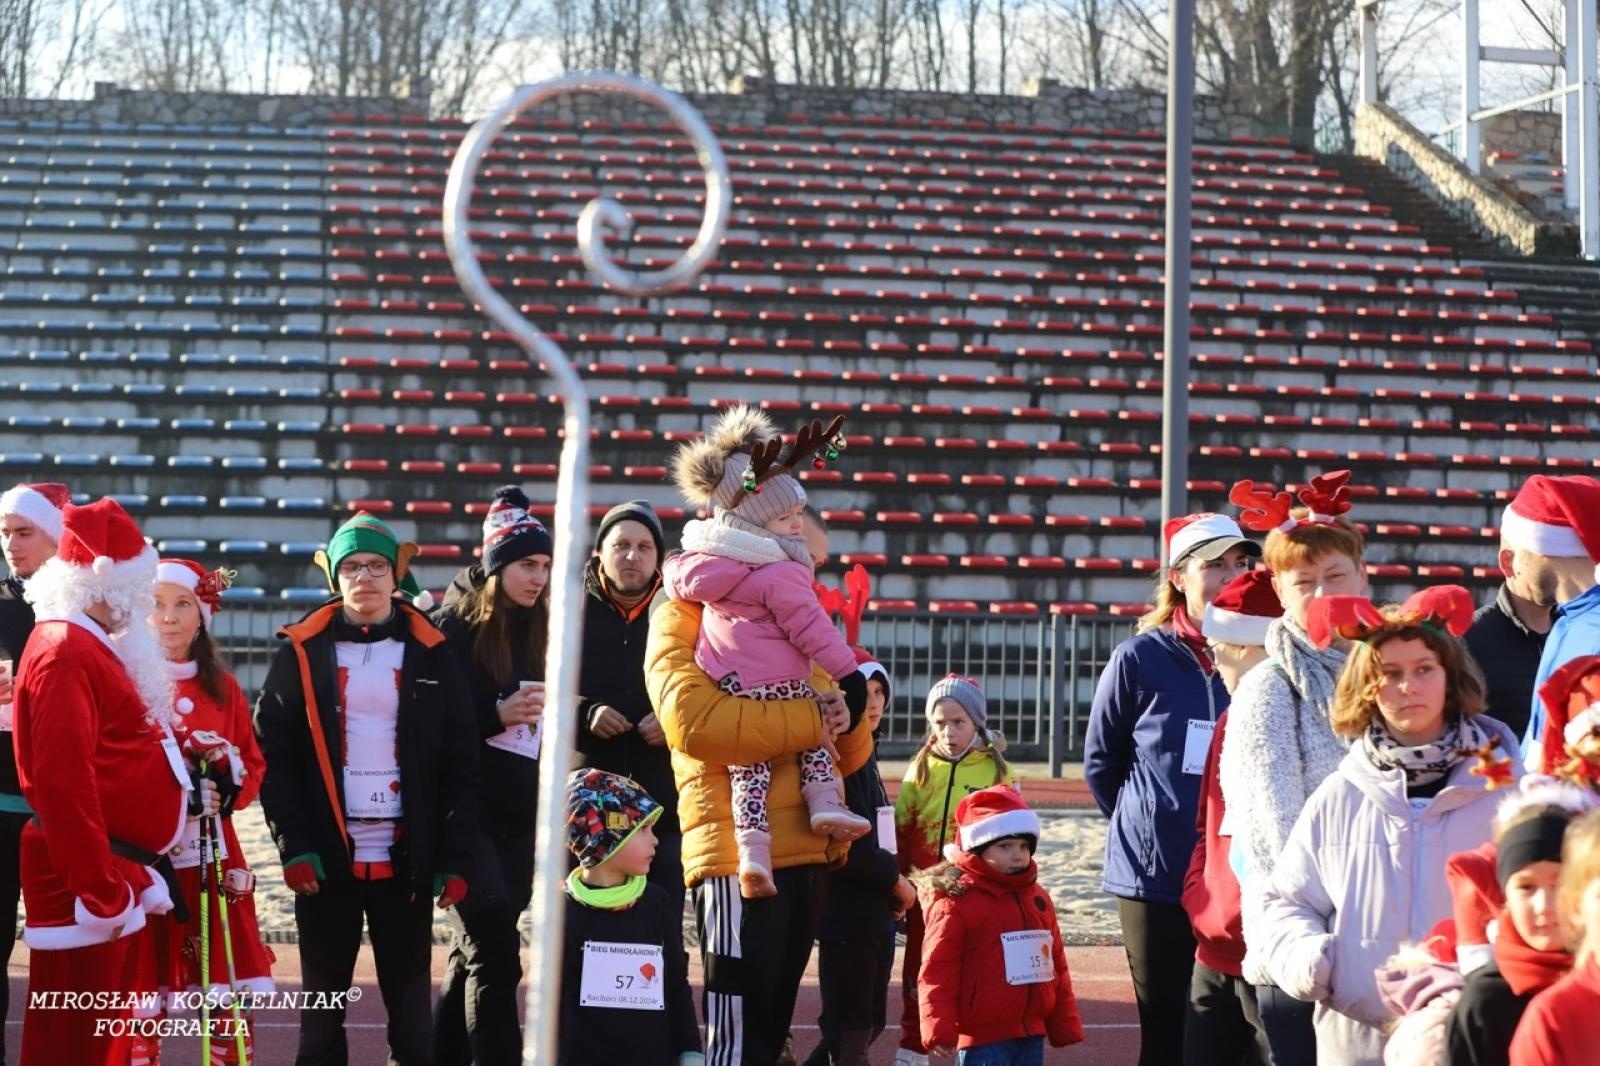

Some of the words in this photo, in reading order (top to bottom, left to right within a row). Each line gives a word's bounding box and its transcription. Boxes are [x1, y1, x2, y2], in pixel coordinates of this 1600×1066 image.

[370, 792, 386, 803] 41
[590, 945, 608, 953] BIEG
[1030, 955, 1041, 968] 15
[615, 975, 635, 989] 57
